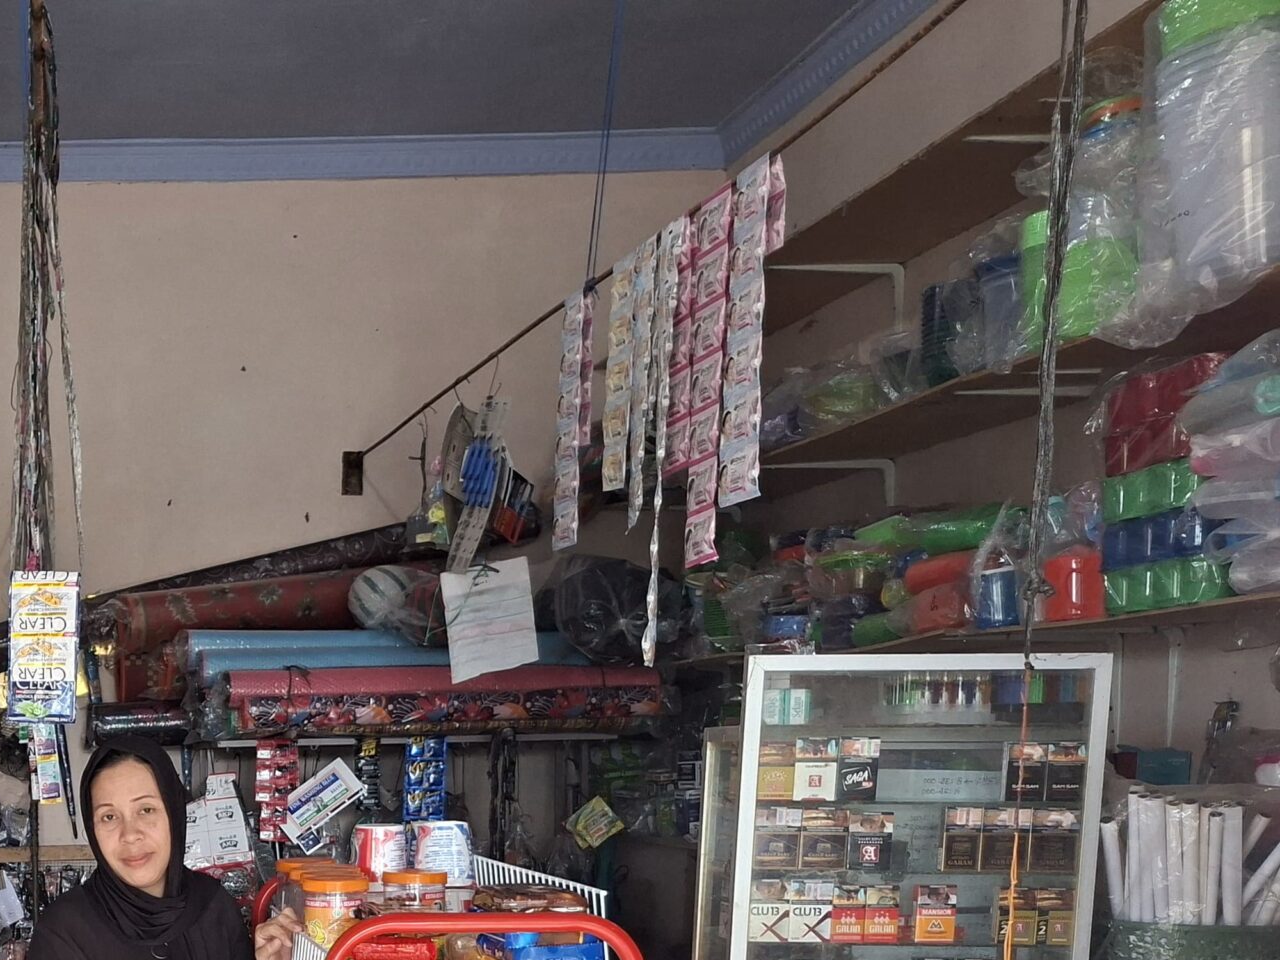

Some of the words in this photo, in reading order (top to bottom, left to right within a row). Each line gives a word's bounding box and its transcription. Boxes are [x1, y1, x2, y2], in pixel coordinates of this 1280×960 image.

[19, 617, 67, 632] CLEAR
[18, 667, 67, 682] CLEAR
[845, 770, 869, 785] SAGA
[921, 908, 952, 916] MANSION
